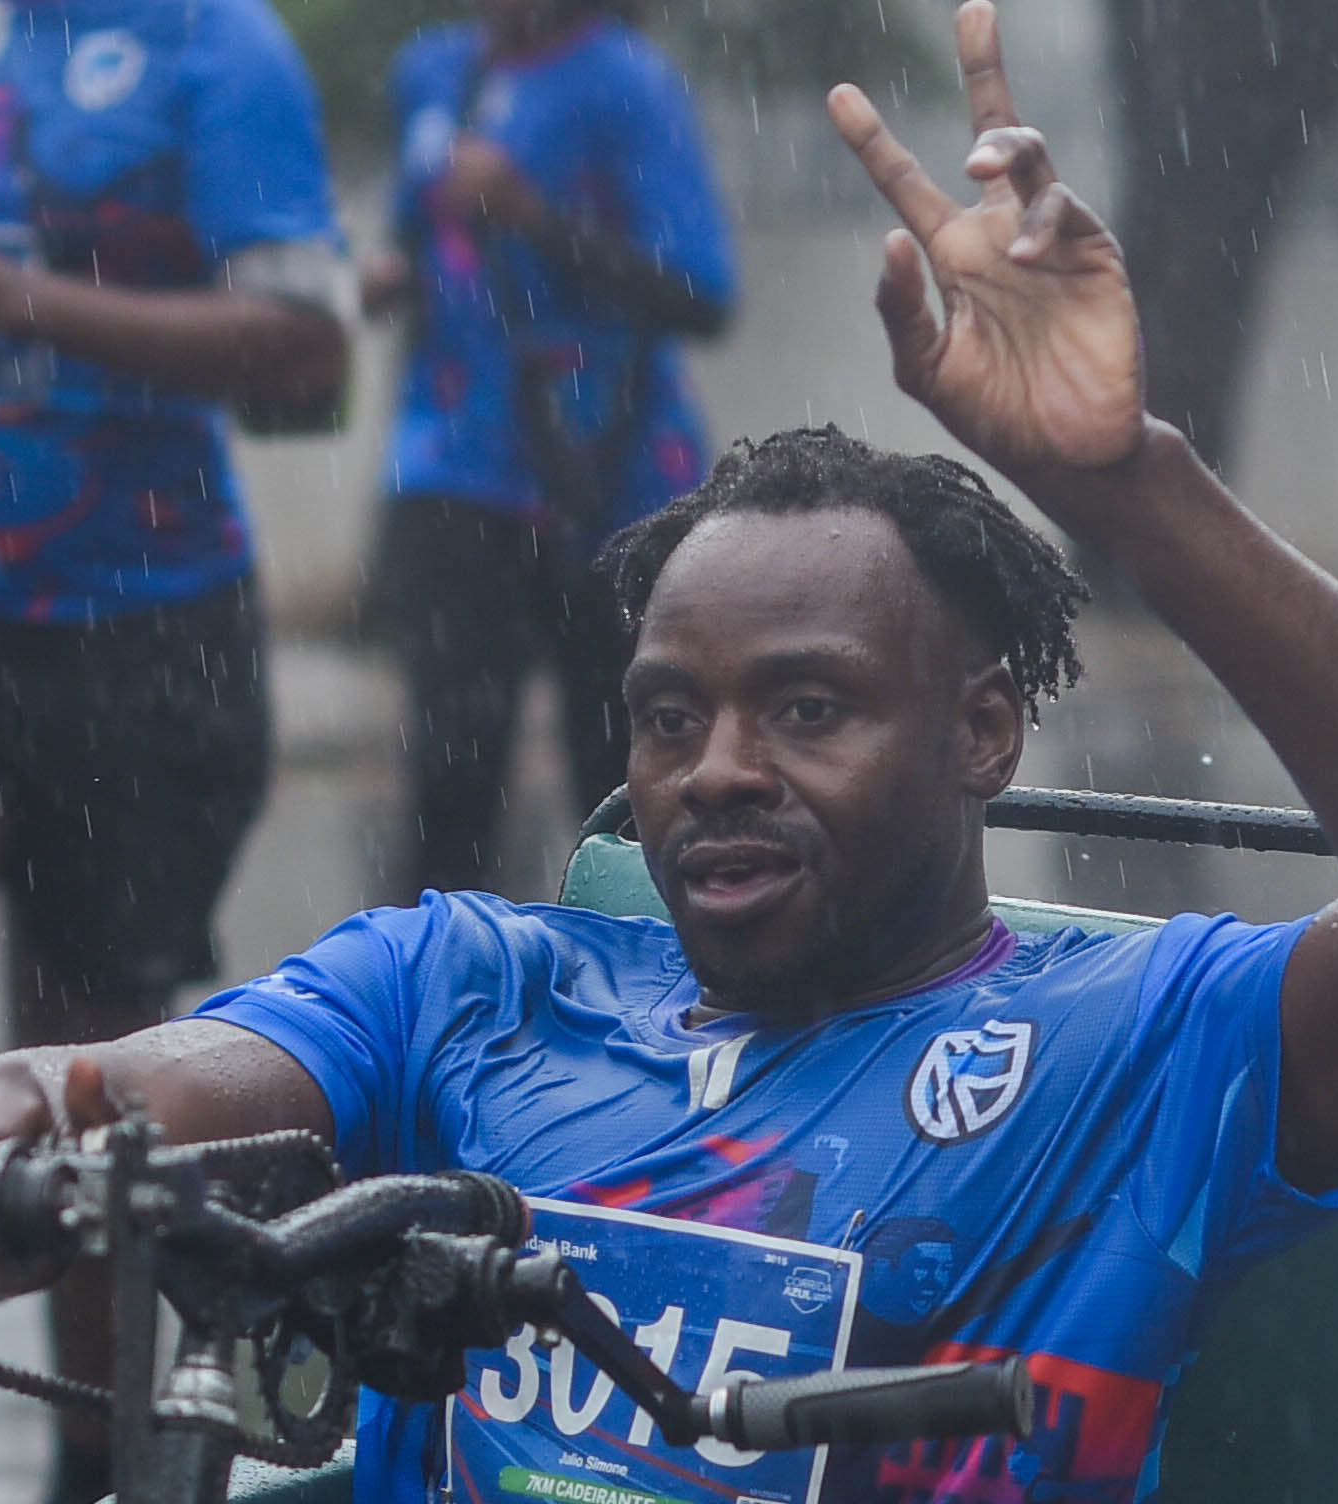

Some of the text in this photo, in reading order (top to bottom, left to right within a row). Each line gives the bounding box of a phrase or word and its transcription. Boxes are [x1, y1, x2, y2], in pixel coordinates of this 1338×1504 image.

[560, 1239, 598, 1262] Bank
[782, 1285, 813, 1301] AZUL
[784, 1275, 833, 1294] CORRIDA
[479, 1292, 791, 1468] 3015
[584, 1455, 629, 1477] Simone
[525, 1473, 555, 1495] 7KM
